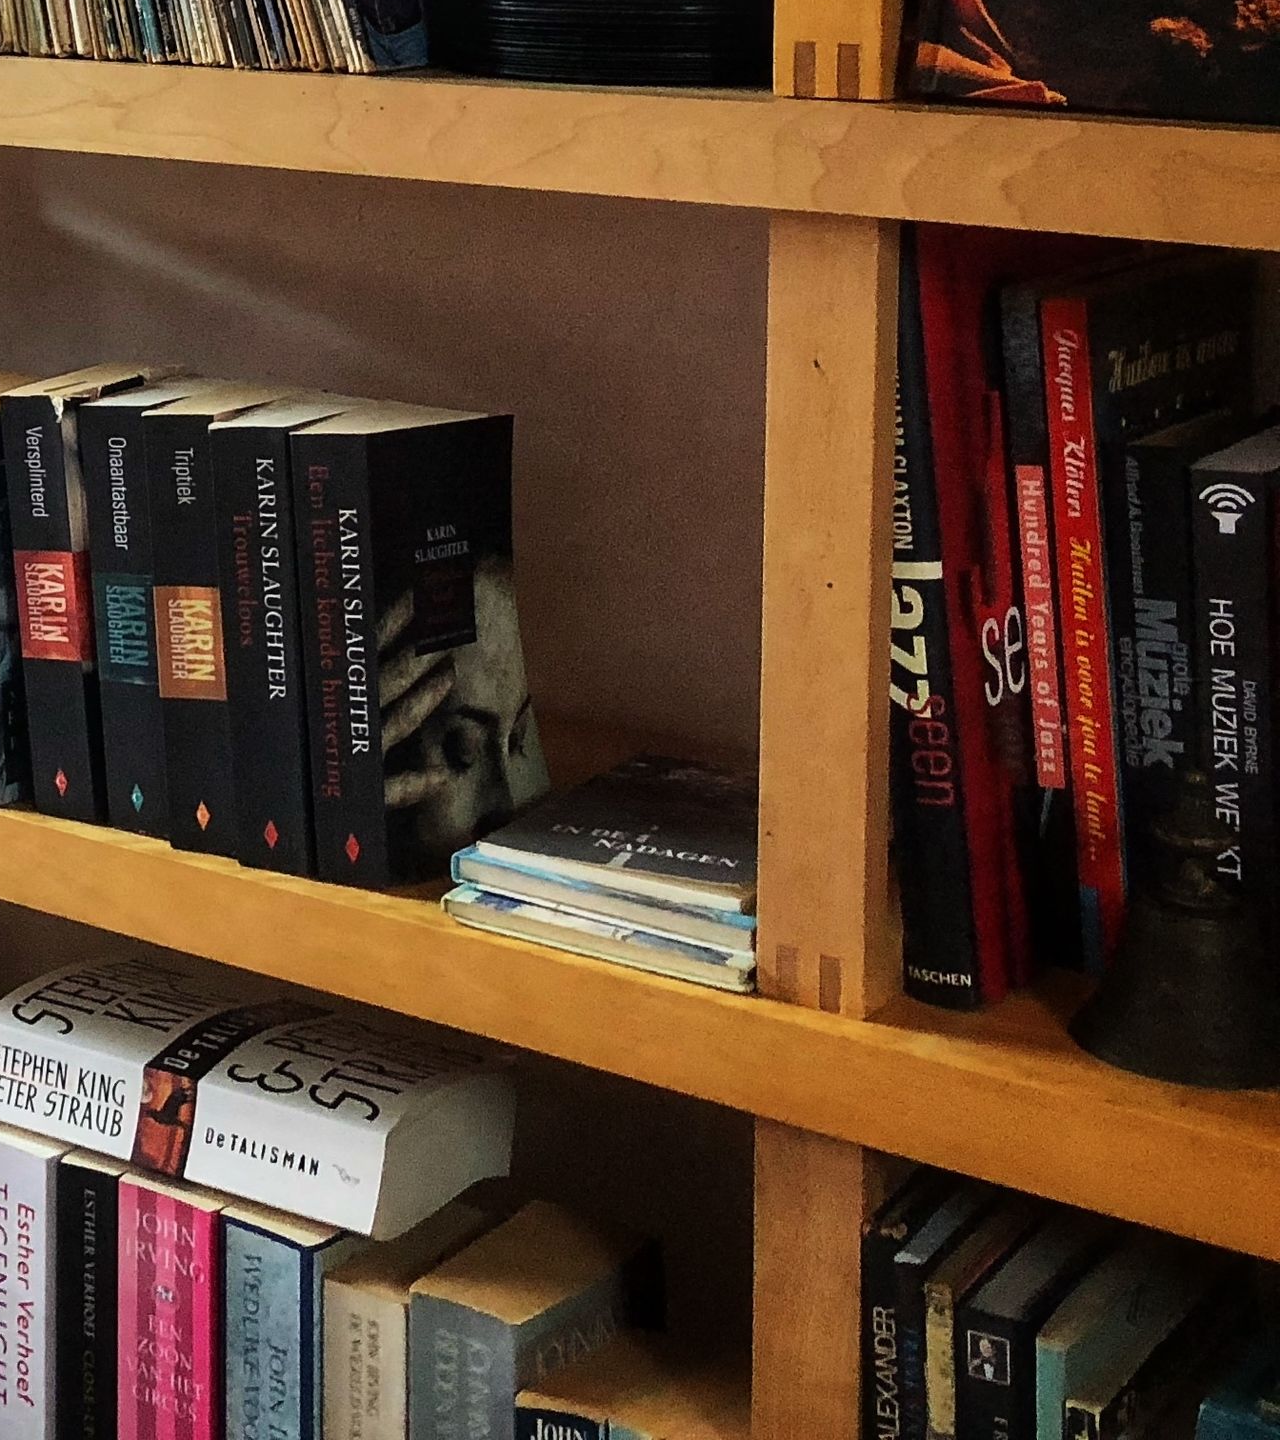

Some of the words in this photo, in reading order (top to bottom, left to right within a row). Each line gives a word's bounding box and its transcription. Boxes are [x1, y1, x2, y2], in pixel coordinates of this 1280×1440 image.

[1052, 328, 1079, 422] Jacques
[24, 425, 49, 519] Versplinterd
[107, 436, 129, 552] Onaantastbaar
[173, 447, 196, 506] Triptiek
[255, 458, 280, 540] KARIN
[338, 508, 362, 590] KARIN
[413, 539, 471, 565] SLAUGHTER
[425, 523, 457, 543] KARIN
[1021, 479, 1050, 589] Hundred
[24, 562, 43, 642] SLAUGHTER
[38, 561, 70, 645] KARIN
[1068, 536, 1094, 622] Huilen
[104, 584, 124, 665] SLAUGHTER
[120, 586, 149, 669] KARIN
[167, 599, 189, 681] SLAUGHTER
[184, 598, 217, 683] KARIN
[260, 547, 288, 701] SLAUGHTER
[1030, 600, 1050, 670] Years
[1074, 629, 1095, 648] is
[1207, 597, 1237, 658] HOE
[343, 596, 371, 756] SLAUGHTER
[1036, 681, 1059, 708] of
[1075, 655, 1094, 709] voor
[1132, 597, 1185, 770] Muziek
[1241, 678, 1258, 723] DAVID
[1038, 718, 1059, 773] Jazz
[1075, 714, 1101, 758] jou
[1210, 667, 1239, 771] MUZIEK
[1243, 725, 1260, 776] BYRNE
[1083, 762, 1103, 787] te
[1214, 781, 1241, 881] WEKT
[907, 964, 973, 988] TASCHEN
[42, 1085, 123, 1139] STRAUB
[76, 1068, 128, 1108] KING
[230, 1133, 321, 1177] TALISMAN
[17, 1203, 36, 1291] Esther
[83, 1187, 96, 1257] ESTHER
[133, 1209, 198, 1250] JOHN
[125, 1238, 206, 1284] IRVING
[82, 1260, 96, 1340] VERHOEF
[147, 1313, 184, 1344] EEN
[16, 1297, 36, 1409] Verhoef
[138, 1334, 193, 1371] ZOON
[132, 1382, 199, 1424] CIRCUS
